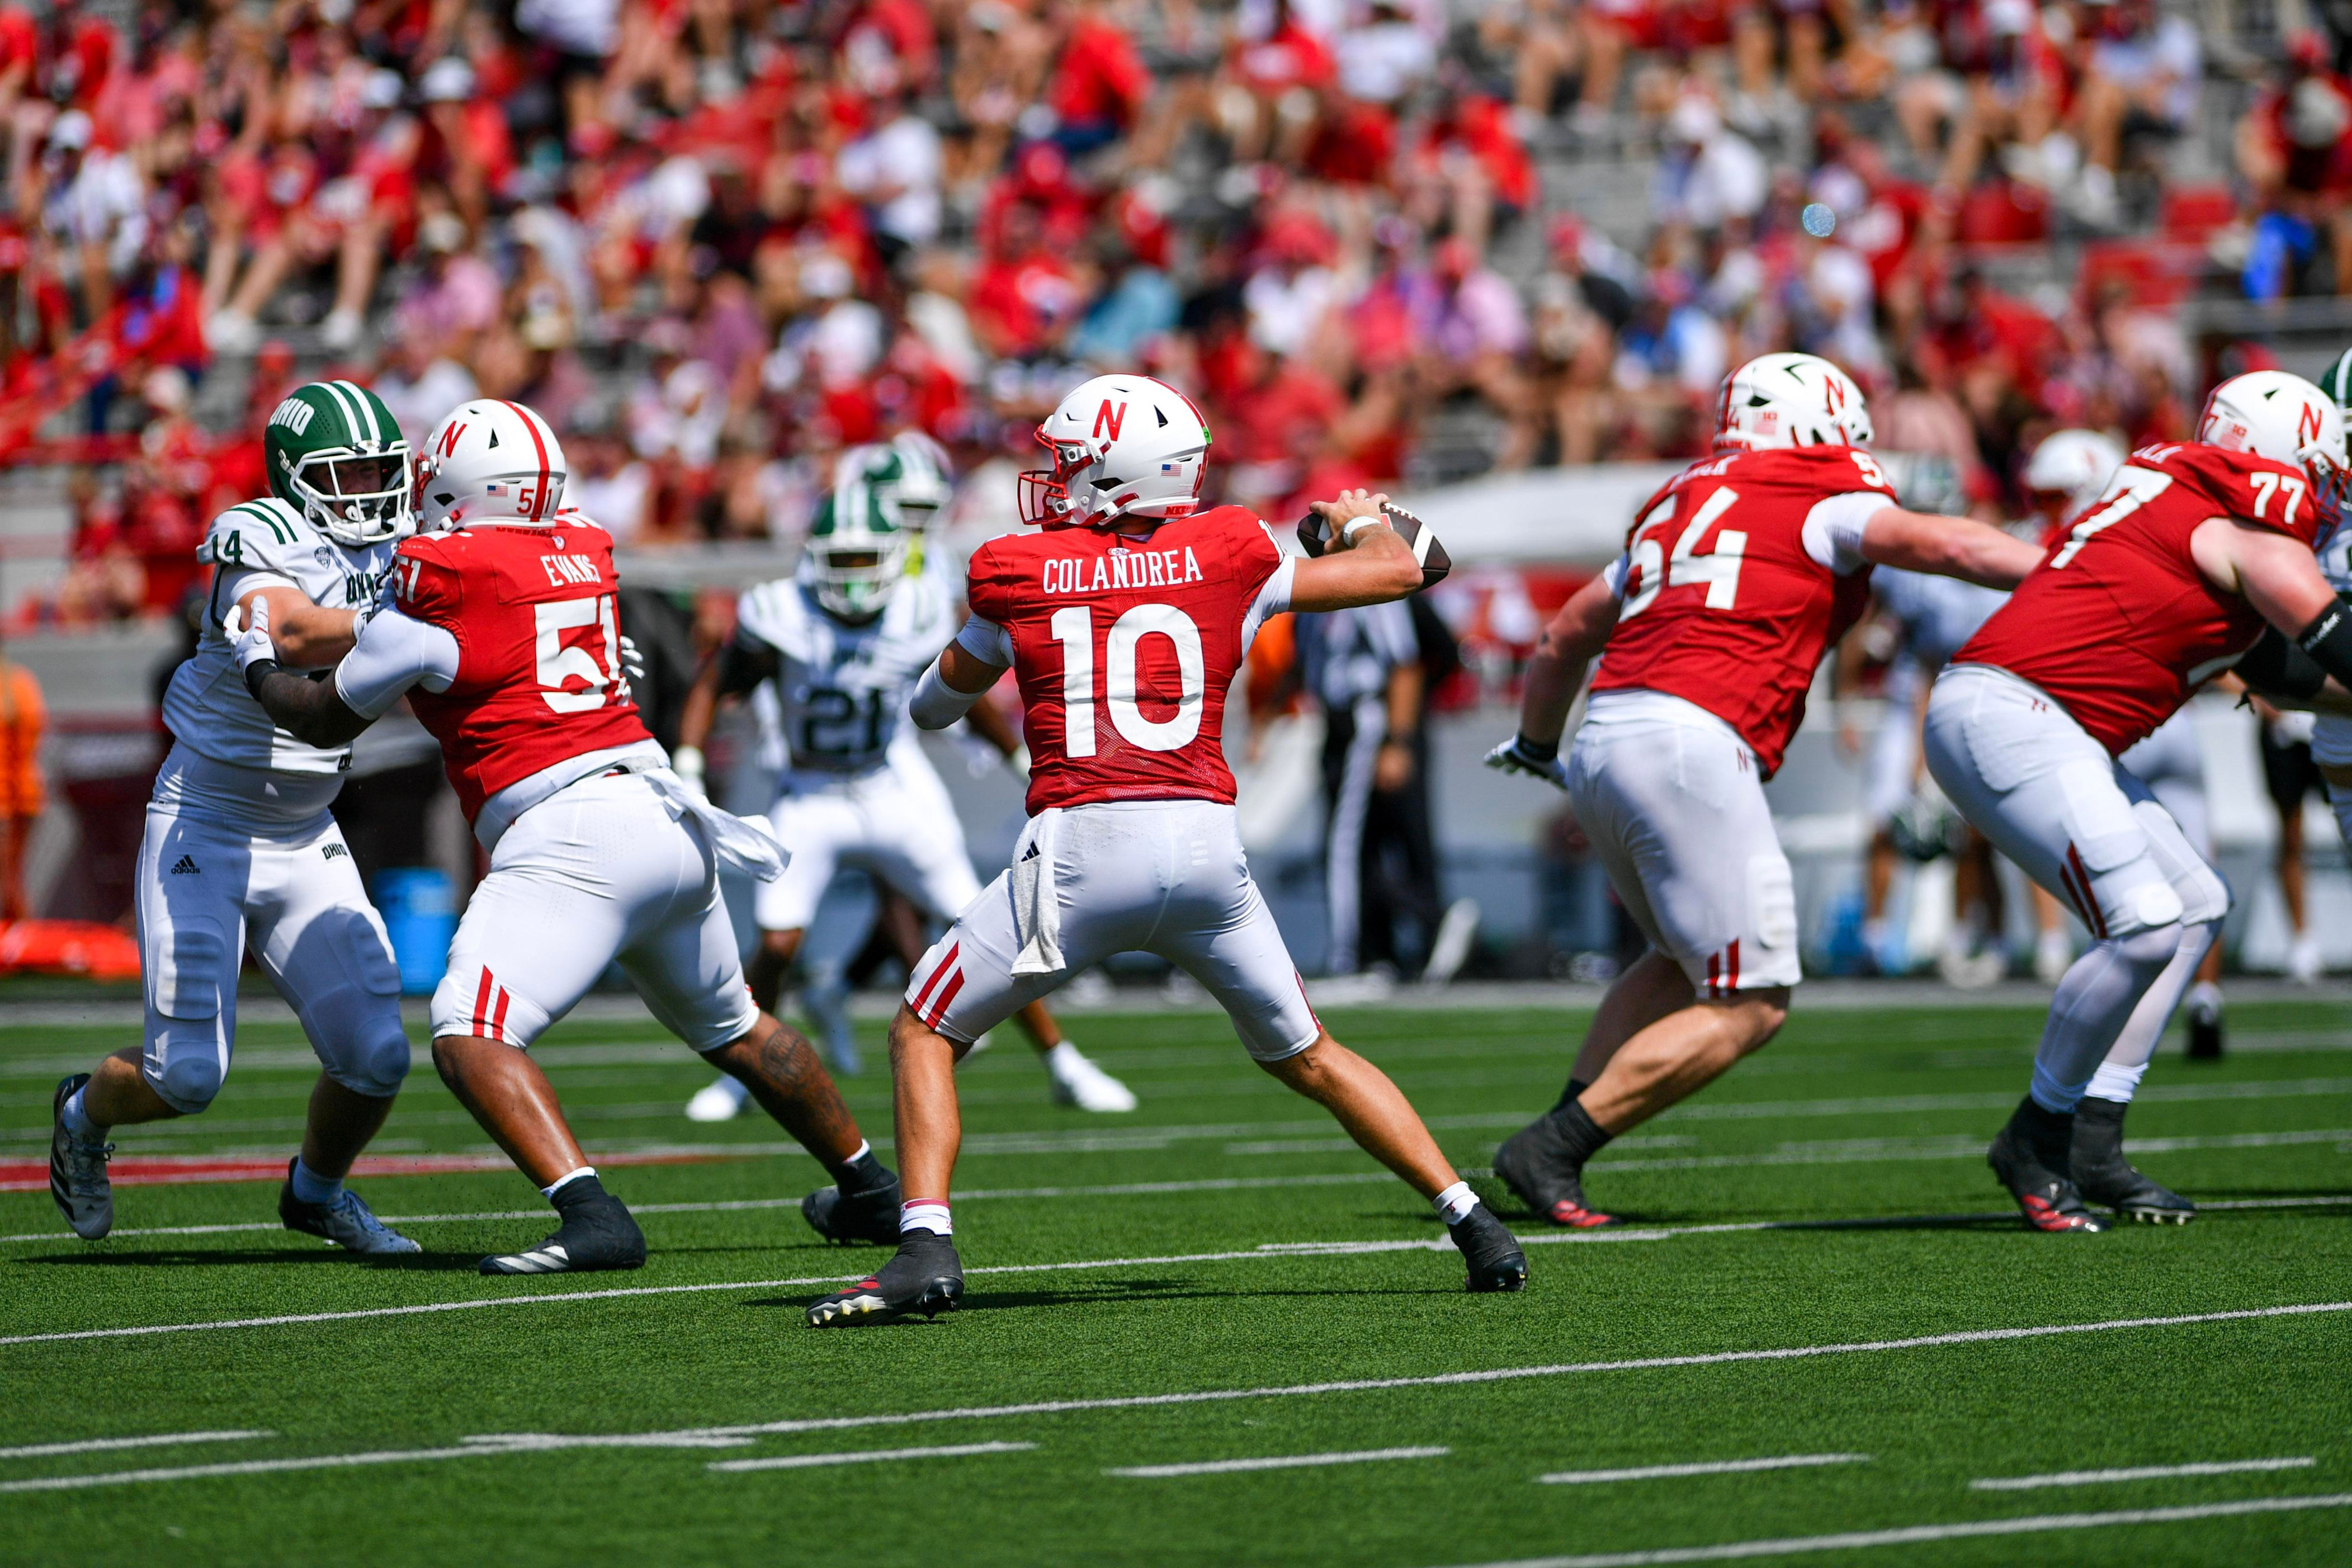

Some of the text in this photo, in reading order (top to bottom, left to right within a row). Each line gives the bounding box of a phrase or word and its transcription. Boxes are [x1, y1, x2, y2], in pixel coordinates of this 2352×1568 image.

[1824, 375, 1844, 415] N
[268, 397, 314, 437] OHIO
[1092, 399, 1127, 441] N
[2298, 402, 2322, 441] N
[436, 421, 467, 458] N
[1849, 451, 1883, 488] 5
[517, 488, 552, 514] 51
[2250, 471, 2305, 525] 77
[212, 530, 243, 565] 14
[346, 573, 380, 603] OHI
[394, 553, 422, 603] 51
[540, 555, 601, 587] EVANS
[1043, 546, 1204, 594] COLANDREA
[534, 594, 631, 714] 51
[1051, 603, 1205, 758] 10
[804, 687, 881, 753] 21
[171, 866, 200, 875] adidas
[322, 843, 348, 859] OHIO
